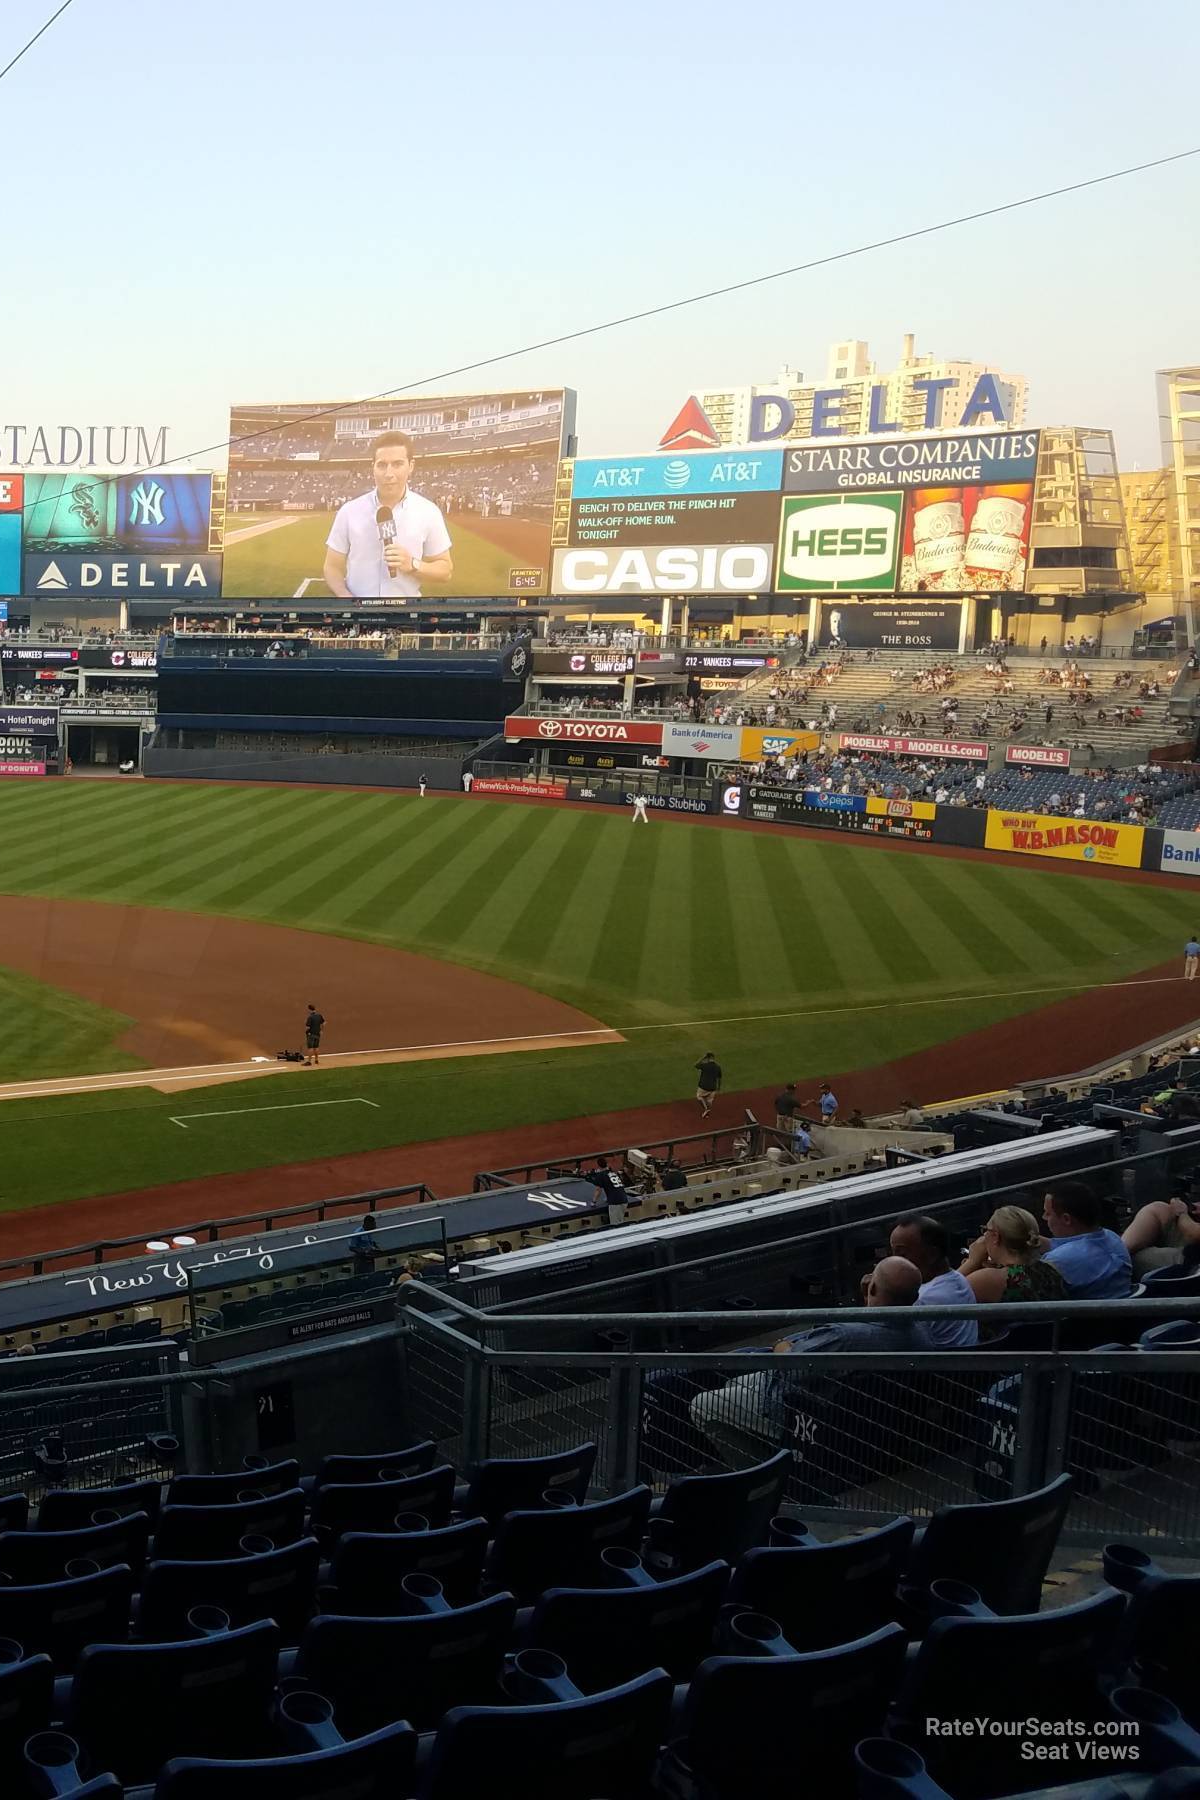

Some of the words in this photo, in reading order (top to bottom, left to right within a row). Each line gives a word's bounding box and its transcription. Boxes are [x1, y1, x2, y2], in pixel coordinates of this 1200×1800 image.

[750, 373, 1007, 442] DELTA
[789, 447, 874, 473] STARR
[879, 434, 1037, 468] COMPANIES
[593, 467, 645, 487] AT&T
[710, 461, 762, 482] AT&T
[837, 472, 894, 487] GLOBAL
[897, 465, 981, 484] INSURANCE
[579, 502, 609, 513] BENCH
[612, 503, 625, 512] TO
[627, 501, 665, 512] DELIVER
[667, 500, 686, 510] THE
[688, 499, 716, 509] PINCH
[719, 498, 736, 508] HIT
[578, 517, 622, 527] WALK-OFF
[625, 516, 652, 525] HOME
[654, 515, 676, 525] RUN.
[577, 530, 619, 540] TONIGHT
[791, 526, 888, 557] HESS
[80, 562, 208, 588] DELTA
[561, 547, 768, 592] CASIO
[515, 577, 536, 587] 6:45
[881, 635, 902, 645] THE
[905, 635, 932, 645] BOSS
[2, 650, 13, 659] 212
[18, 650, 43, 659] YANKEES
[591, 655, 620, 663] COLLEGE
[594, 662, 612, 672] SUNY
[685, 657, 698, 667] 212
[703, 657, 732, 667] YANKEES
[564, 723, 628, 739] TOYOTA
[672, 727, 690, 737] Bank
[690, 728, 700, 739] of
[700, 729, 733, 740] America
[762, 737, 788, 754] SAP
[844, 736, 889, 749] MODELL'S
[908, 741, 982, 757] MODELLS.com
[641, 755, 670, 767] FedEx
[1012, 749, 1063, 762] MODELL'S
[759, 790, 793, 800] GATORADE
[829, 796, 854, 807] pepsi
[668, 796, 707, 812] StubHub
[753, 803, 767, 812] WHITE
[767, 804, 777, 812] SOX
[753, 811, 775, 819] YANKEES
[1002, 818, 1019, 829] WHO
[1021, 819, 1037, 829] BUT
[1012, 825, 1119, 850] W.B.MASON
[65, 1273, 153, 1296] New
[300, 1323, 315, 1333] ALERT
[315, 1321, 325, 1330] FOR
